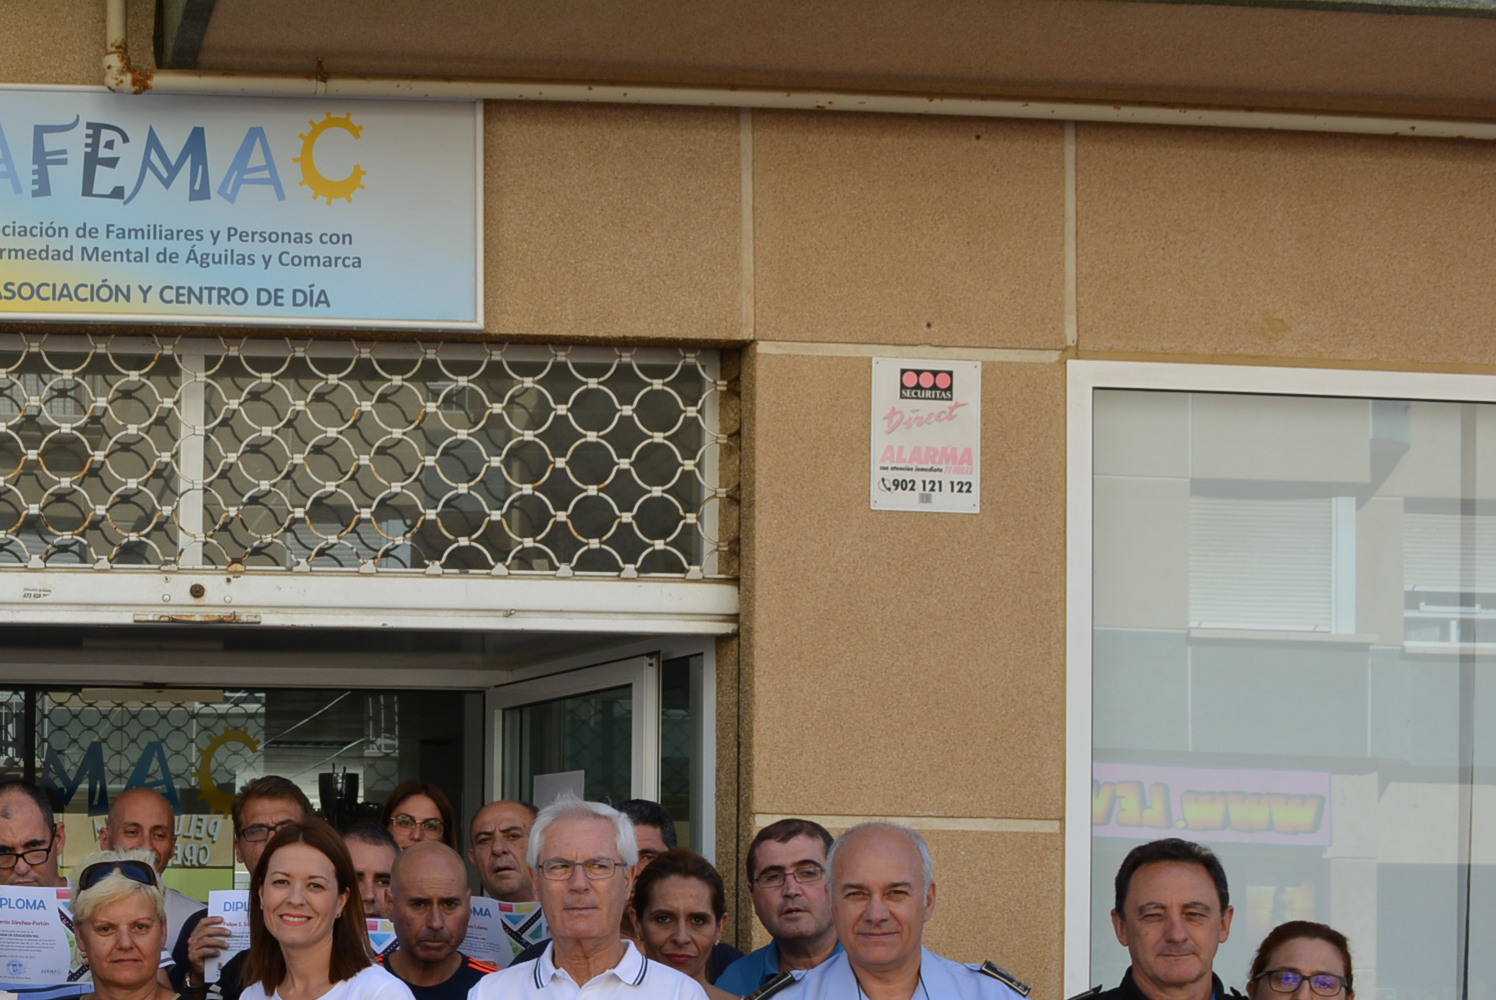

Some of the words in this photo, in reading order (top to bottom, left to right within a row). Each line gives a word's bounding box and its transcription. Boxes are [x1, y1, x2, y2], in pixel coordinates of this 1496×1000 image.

[75, 222, 99, 239] de
[106, 223, 204, 242] Familiares
[210, 230, 221, 245] y
[227, 226, 313, 244] Personas
[319, 232, 353, 246] con
[81, 246, 149, 264] Mental
[156, 247, 179, 264] de
[186, 244, 255, 268] Águilas
[261, 254, 272, 270] y
[278, 251, 362, 269] Comarca
[138, 284, 153, 304] Y
[159, 285, 249, 306] CENTRO
[256, 287, 284, 306] DE
[292, 284, 331, 308] DÍA
[901, 389, 952, 399] SECURITAS
[883, 401, 968, 435] Direct
[880, 445, 973, 465] ALARMA
[892, 478, 916, 491] 902
[922, 480, 942, 492] 121
[950, 481, 972, 493] 122
[224, 901, 248, 912] DIPL
